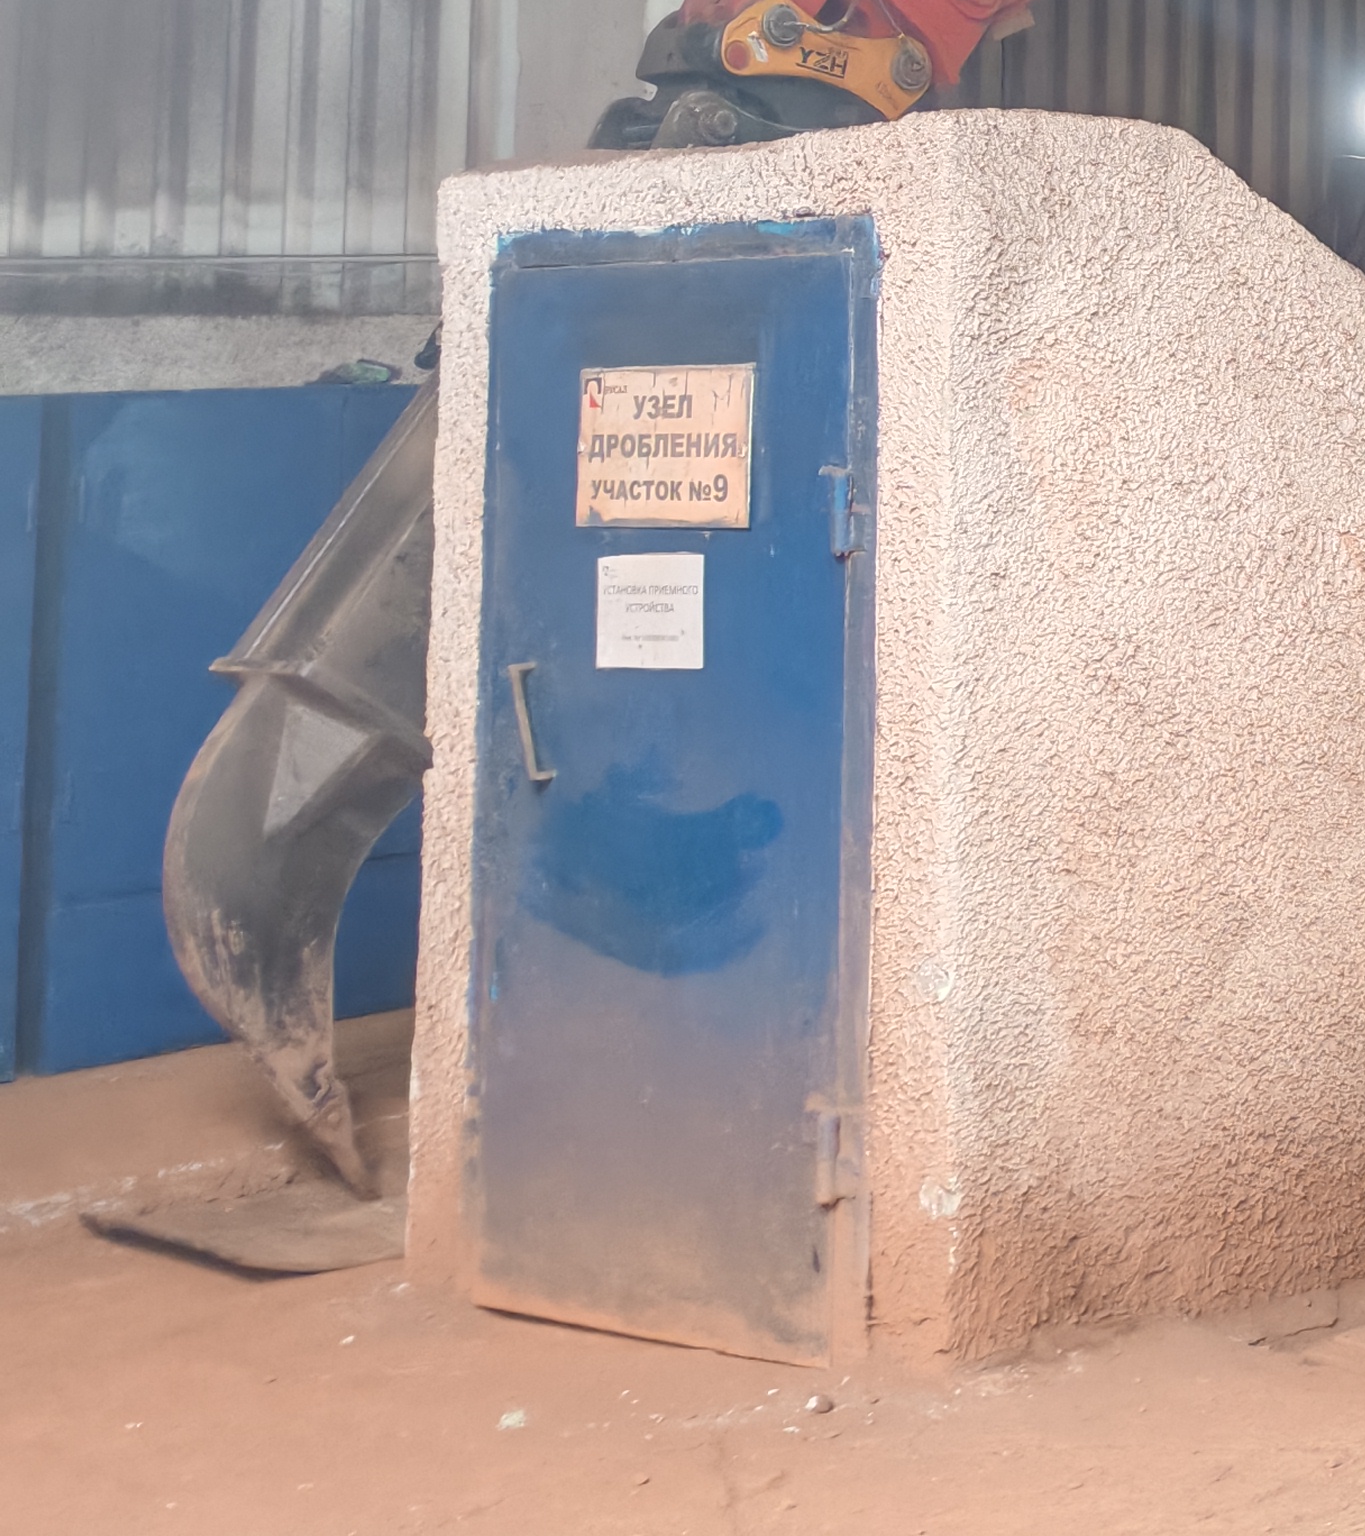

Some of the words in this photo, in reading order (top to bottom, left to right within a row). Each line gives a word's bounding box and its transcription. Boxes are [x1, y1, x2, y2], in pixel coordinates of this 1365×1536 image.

[799, 46, 848, 79] YZH
[632, 394, 693, 420] УЗЕЛ
[588, 432, 738, 463] ДРОБЛЕНИЯ
[591, 479, 682, 502] УЧАСТОК
